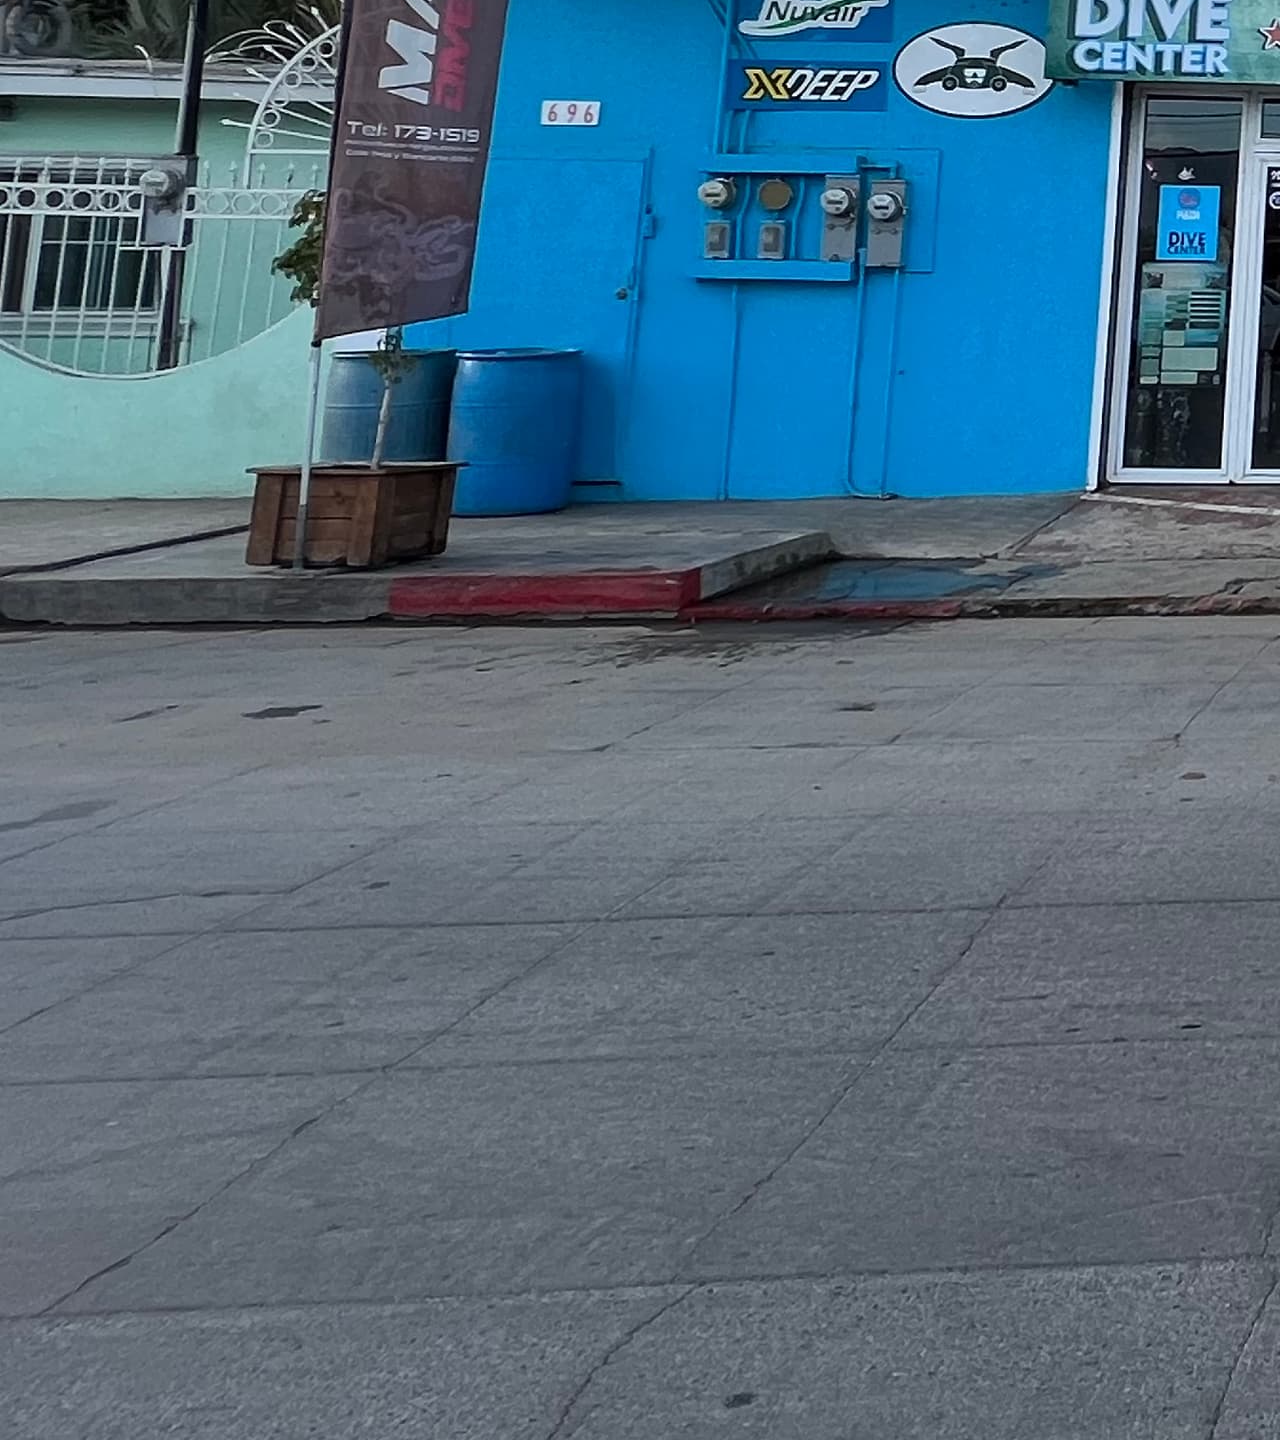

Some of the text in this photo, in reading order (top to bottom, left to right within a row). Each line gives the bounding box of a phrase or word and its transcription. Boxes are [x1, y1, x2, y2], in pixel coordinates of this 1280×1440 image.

[764, 0, 862, 23] Nuvair
[1072, 41, 1229, 73] CENTER
[743, 68, 880, 101] XDEEP
[347, 121, 481, 143] Tel: 173-1519
[1168, 232, 1207, 247] DIVE
